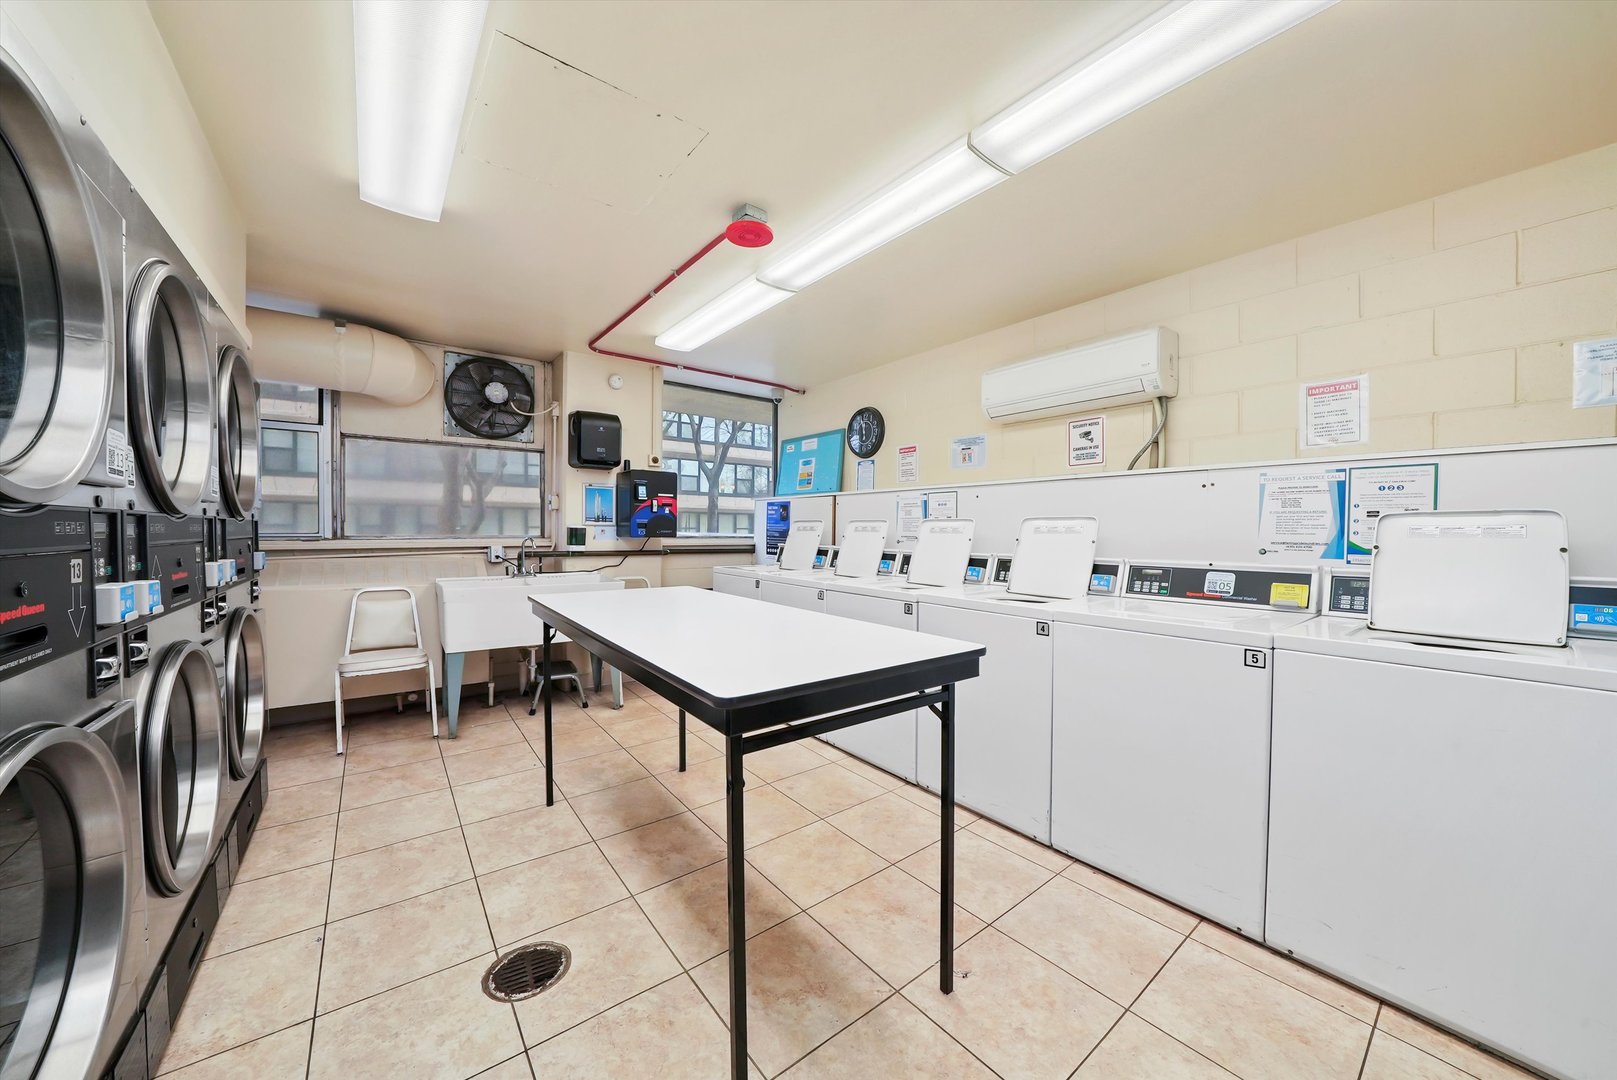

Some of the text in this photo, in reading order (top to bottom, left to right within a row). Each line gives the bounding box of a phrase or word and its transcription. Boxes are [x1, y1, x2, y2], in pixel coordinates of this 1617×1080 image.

[1309, 382, 1357, 395] IMPORTANT
[71, 562, 82, 579] 13
[1218, 582, 1232, 590] 05
[0, 604, 45, 624] peed Queen
[1251, 654, 1258, 664] 5
